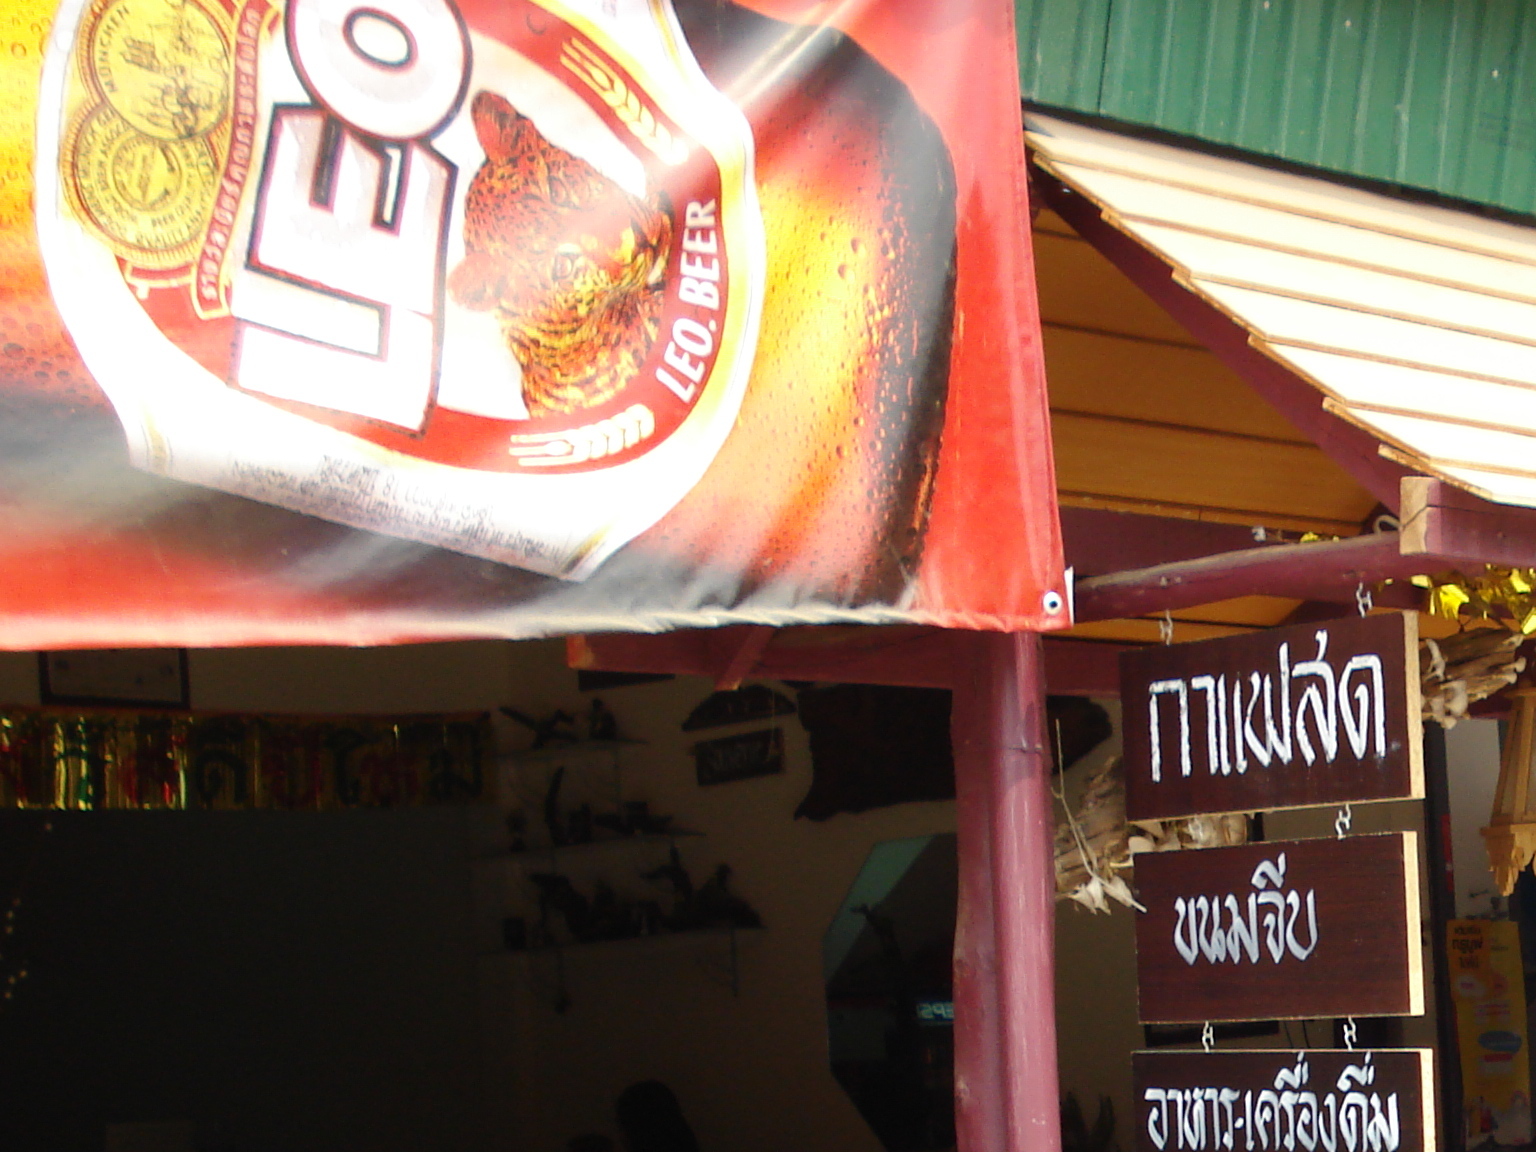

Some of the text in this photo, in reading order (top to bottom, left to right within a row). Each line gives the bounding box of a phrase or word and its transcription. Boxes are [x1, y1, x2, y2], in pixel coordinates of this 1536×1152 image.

[228, 0, 473, 439] LEO
[677, 198, 725, 305] BEER
[1173, 851, 1319, 966] ขนมจีบ
